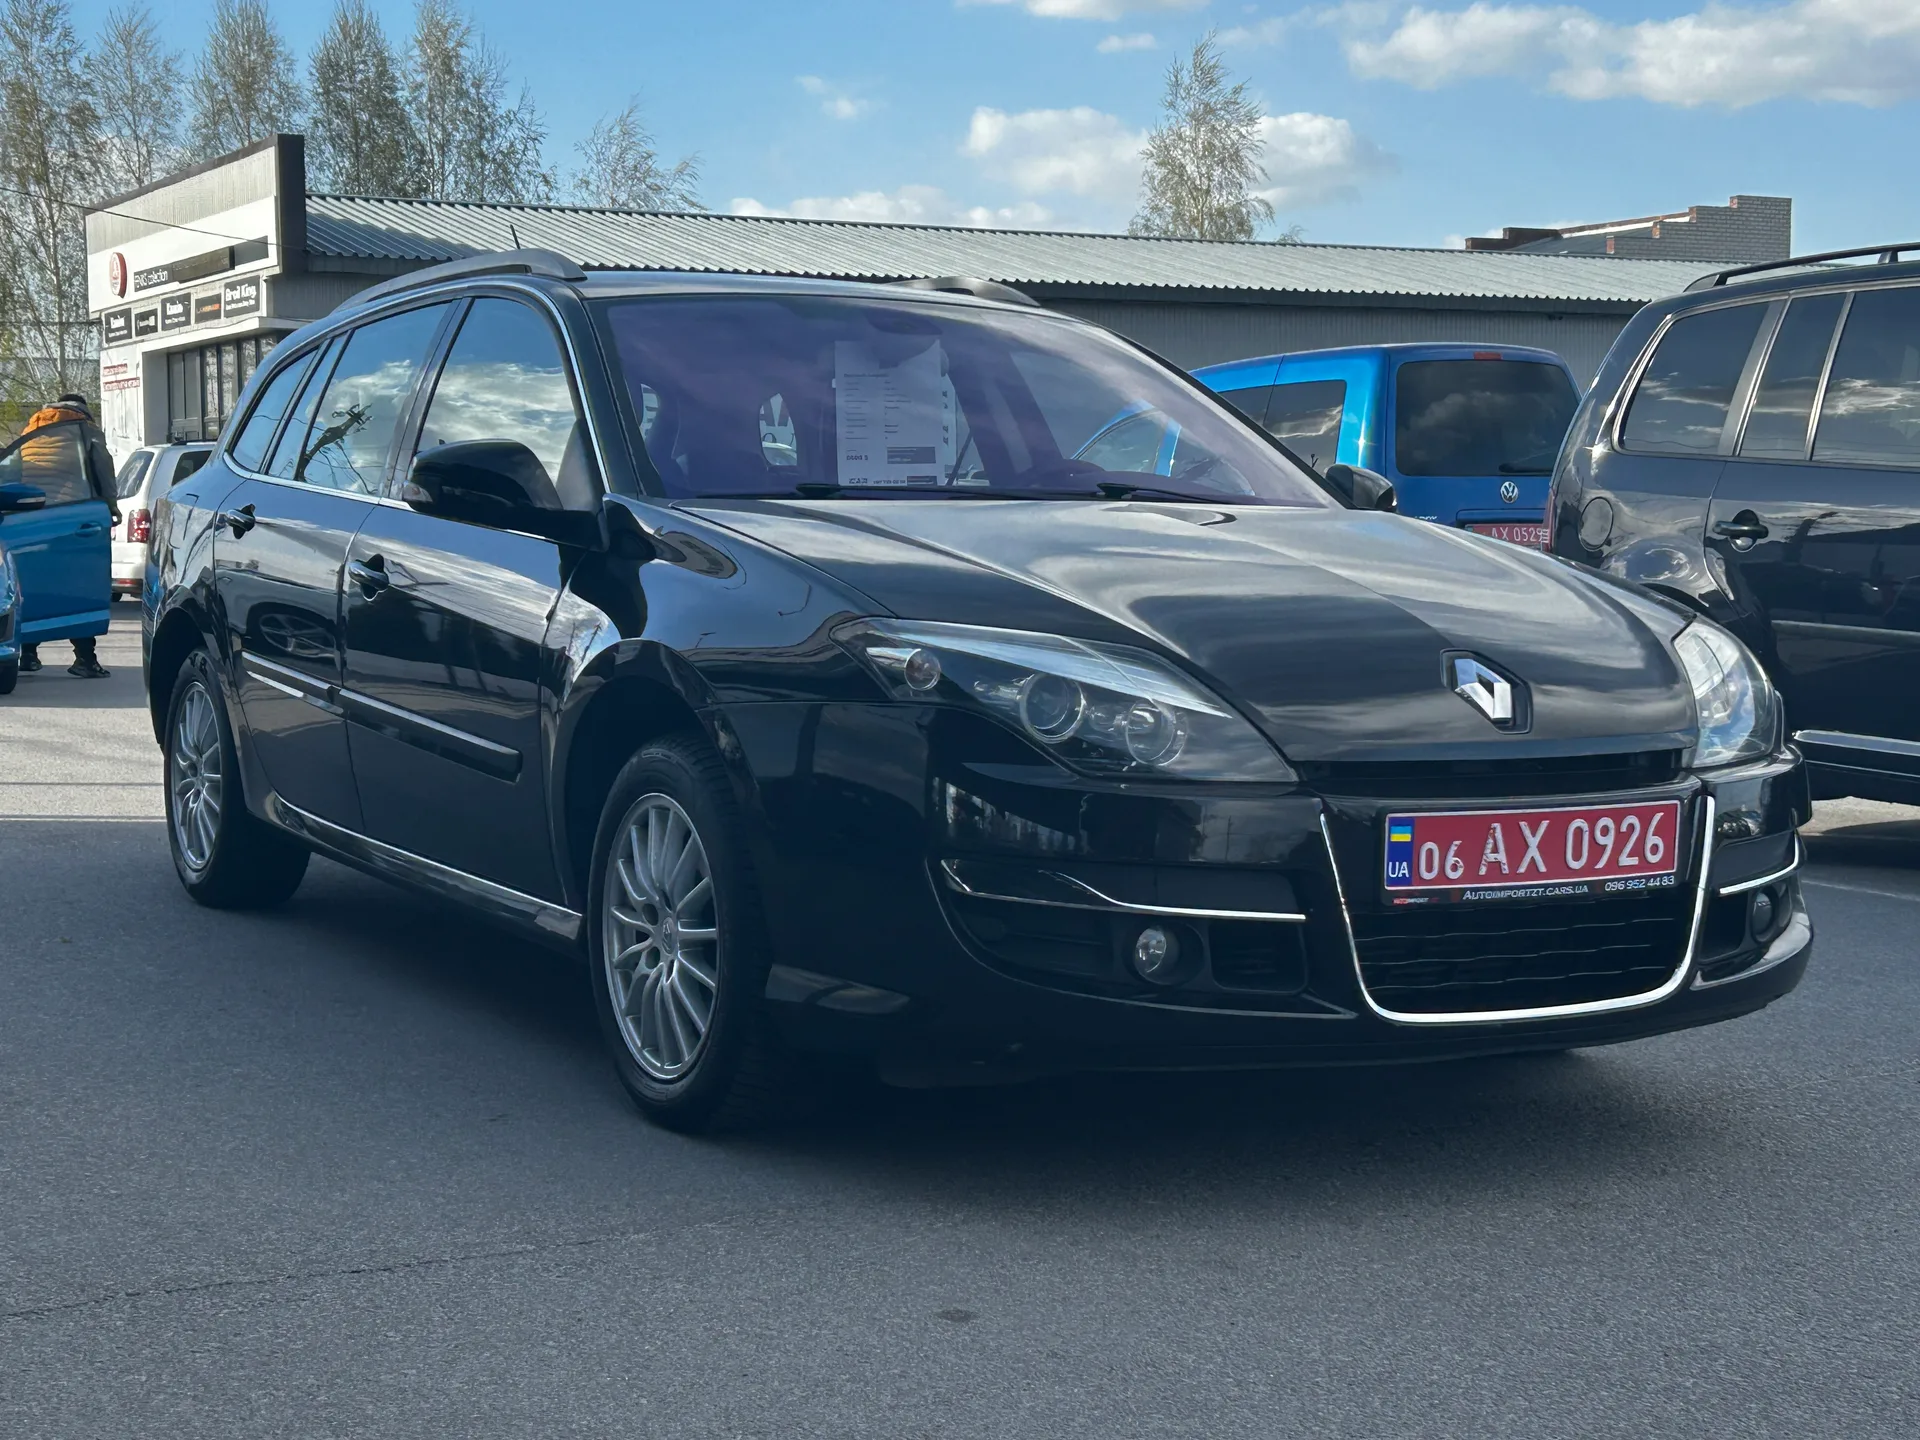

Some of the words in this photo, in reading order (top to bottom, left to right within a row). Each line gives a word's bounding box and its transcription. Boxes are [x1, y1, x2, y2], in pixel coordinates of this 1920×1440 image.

[1419, 841, 1464, 880] 06
[1479, 820, 1550, 876] AX
[1566, 812, 1664, 870] 0926
[1388, 861, 1409, 878] UA
[1604, 880, 1625, 891] 096
[1626, 879, 1645, 889] 952
[1647, 877, 1660, 886] 44
[1661, 875, 1675, 885] 83
